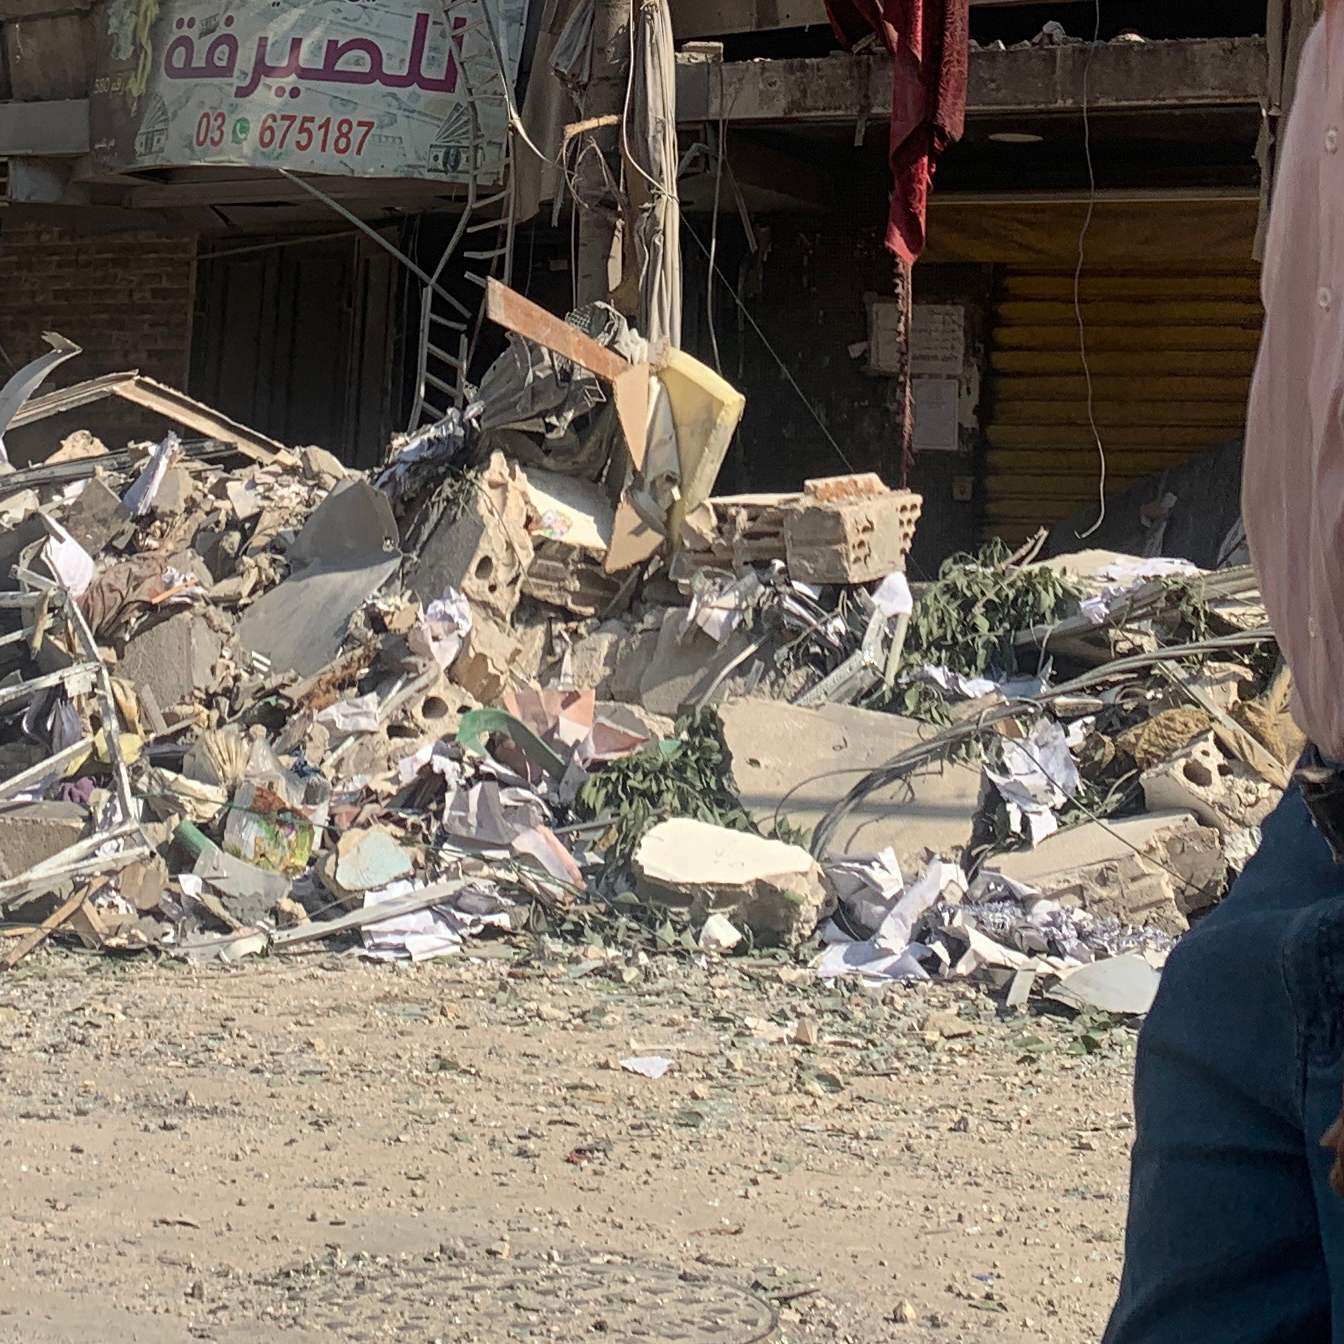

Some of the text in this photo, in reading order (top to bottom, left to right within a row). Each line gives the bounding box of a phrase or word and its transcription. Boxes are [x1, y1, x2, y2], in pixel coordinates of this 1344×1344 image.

[164, 12, 467, 99] للصيرفة
[196, 111, 376, 156] 03 675187
